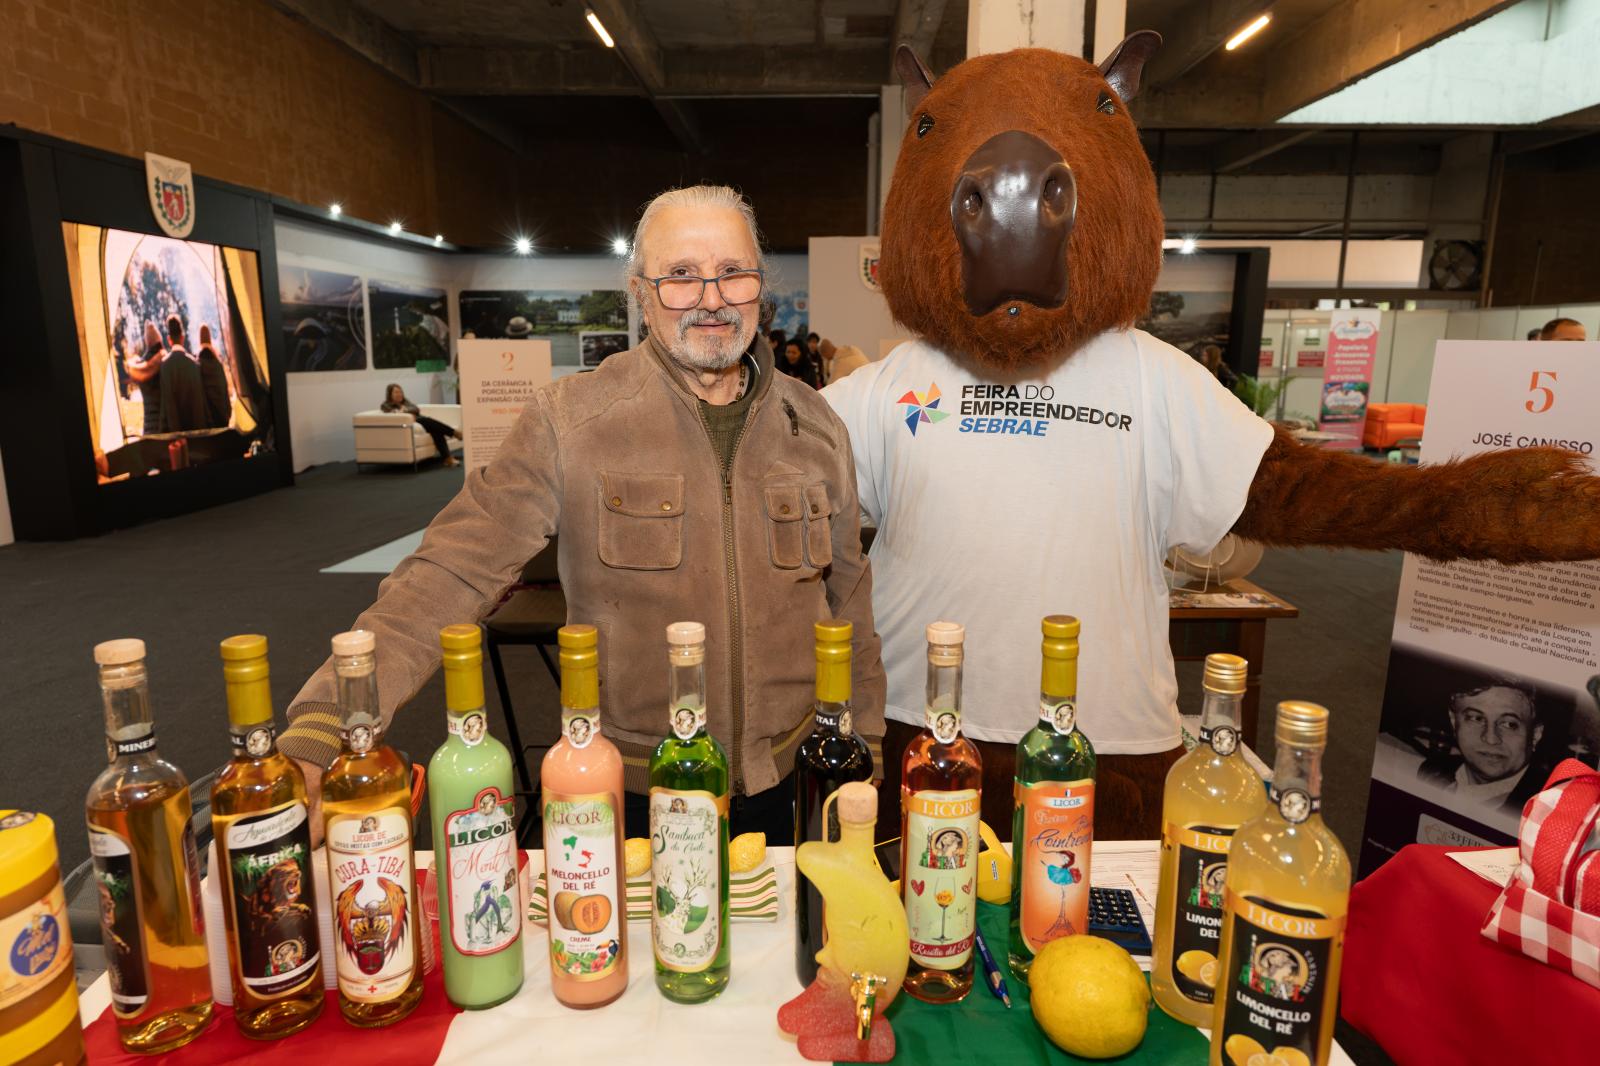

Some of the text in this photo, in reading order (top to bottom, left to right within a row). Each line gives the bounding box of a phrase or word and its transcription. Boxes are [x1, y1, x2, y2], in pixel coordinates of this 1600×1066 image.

[502, 352, 514, 371] 2
[961, 384, 1055, 400] FEIRA DO
[1525, 371, 1557, 413] 5
[960, 400, 1132, 431] EMPREENDEDOR
[958, 417, 1050, 437] SEBRAE
[1472, 432, 1593, 454] JOSÉ CANISSO
[1550, 576, 1596, 590] abundância
[1551, 594, 1588, 608] defender
[1540, 629, 1551, 637] da
[1552, 632, 1577, 644] Louça
[1521, 642, 1548, 655] Capital
[1550, 650, 1585, 664] Nacional
[1586, 659, 1597, 668] da
[1551, 641, 1590, 656] conquista
[922, 802, 973, 817] LICOR
[1053, 799, 1081, 807] LICOR
[551, 810, 601, 826] LICOR
[454, 818, 514, 847] LICOR
[653, 825, 704, 855] Sambuca
[551, 867, 610, 881] MELONCELLO
[562, 880, 596, 892] DEL RÉ
[1248, 905, 1317, 936] LICOR
[1199, 926, 1219, 939] DEL
[1236, 990, 1312, 1023] LIMONCELLO
[1249, 1011, 1293, 1035] DEL RÉ
